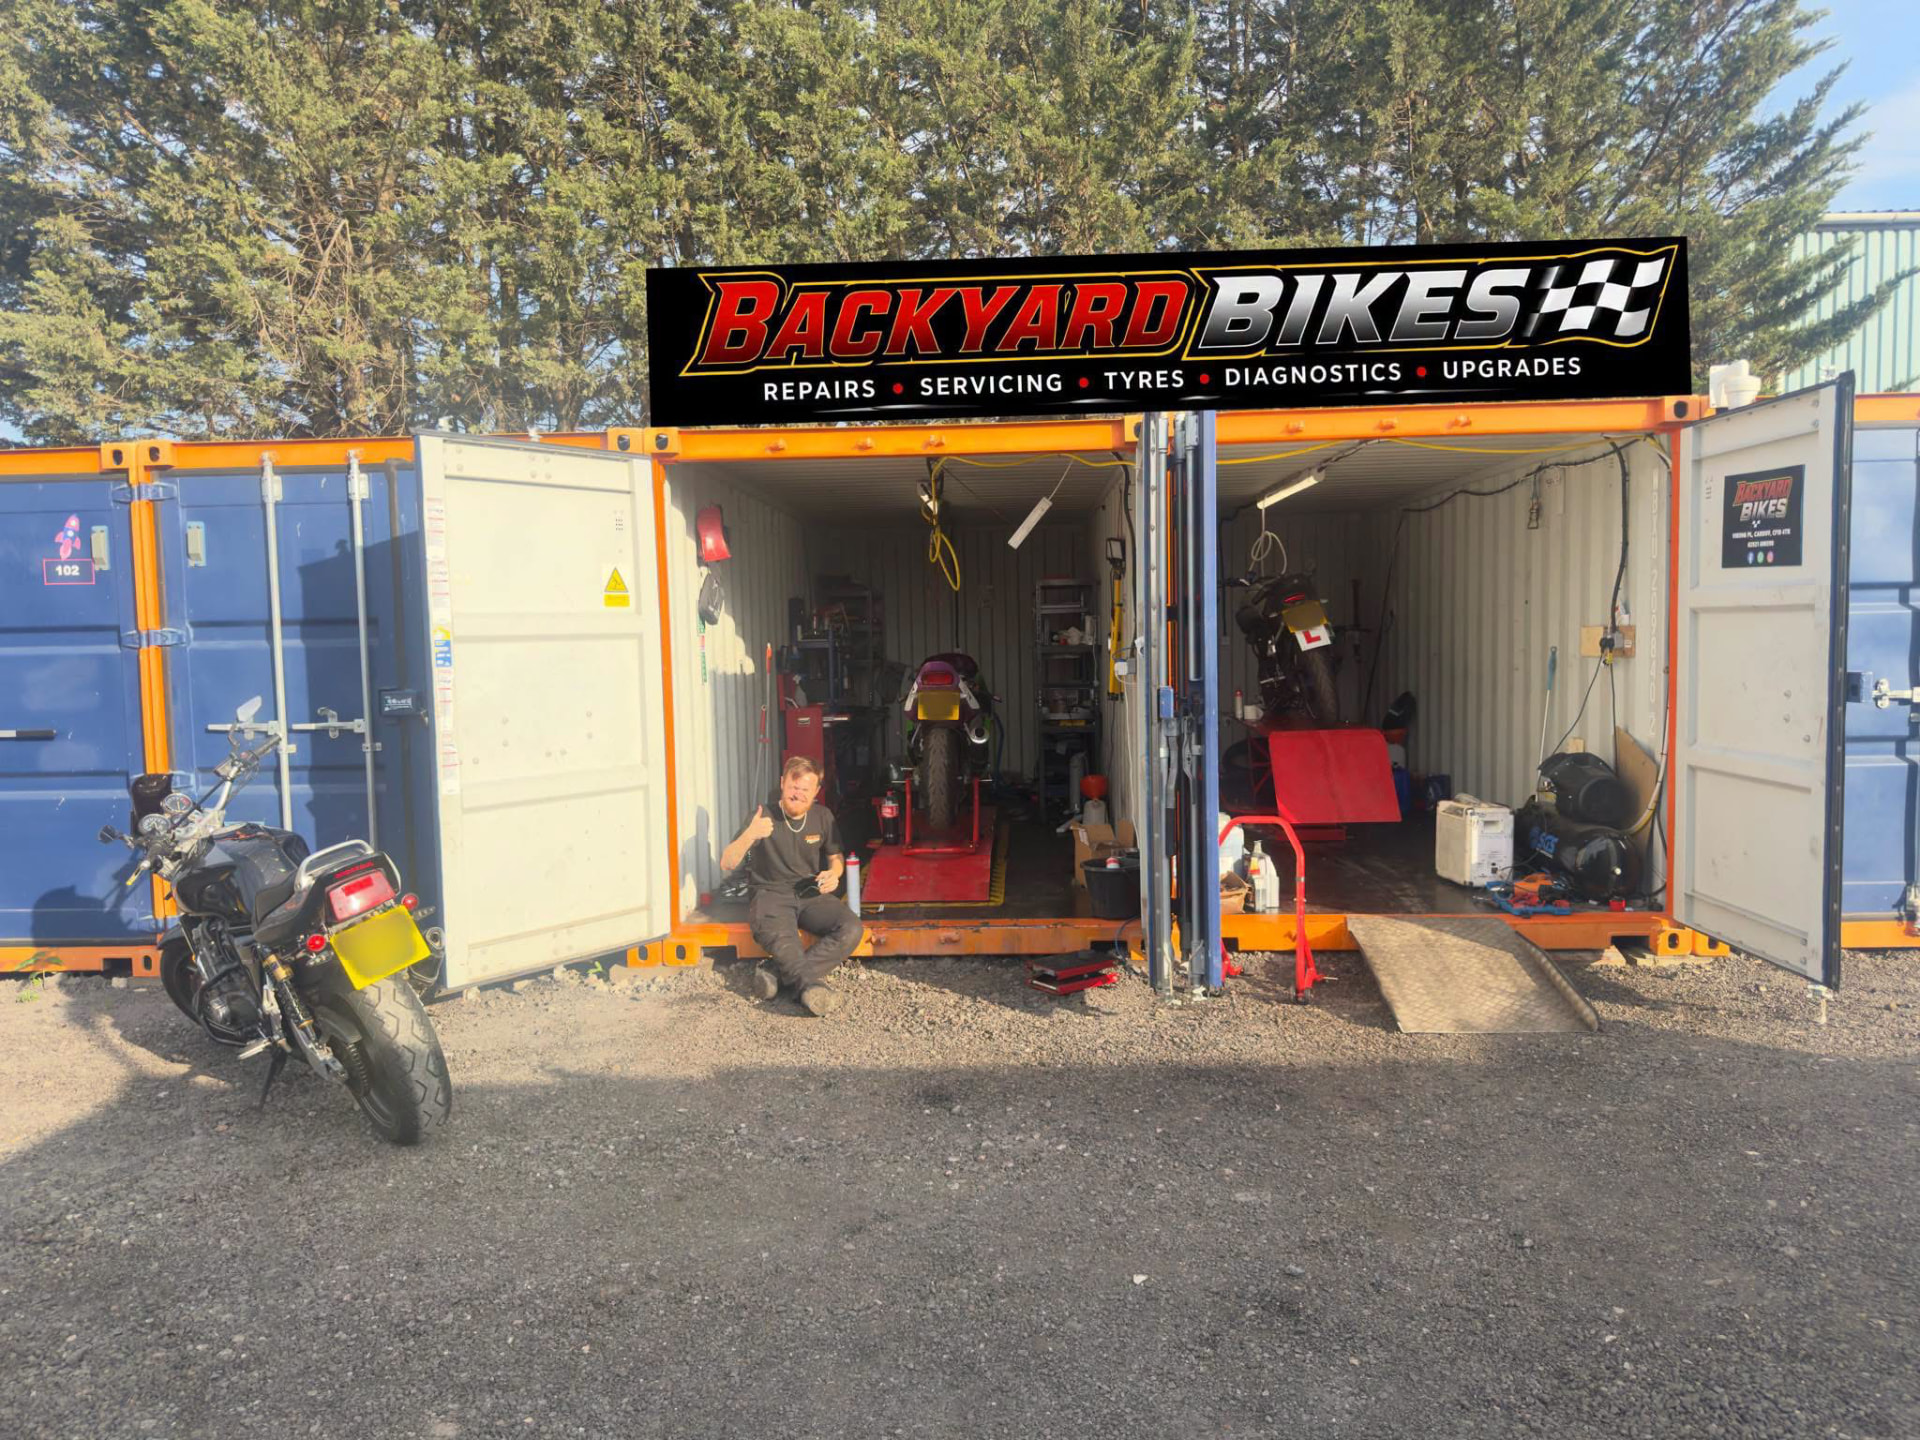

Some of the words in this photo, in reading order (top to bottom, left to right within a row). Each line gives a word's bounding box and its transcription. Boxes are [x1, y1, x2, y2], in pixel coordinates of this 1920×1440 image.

[700, 279, 1190, 365] BACKYARD
[1198, 268, 1532, 349] BIKES
[764, 379, 876, 401] REPAIRS
[920, 373, 1063, 396] SERVICING
[1104, 369, 1184, 390] TYRES
[1225, 362, 1402, 387] DIAGNOSTICS
[1442, 356, 1582, 380] UPGRADES
[1736, 479, 1792, 504] BACKYARD
[1740, 498, 1787, 522] BIKES
[55, 564, 80, 577] 102
[1302, 630, 1321, 644] L
